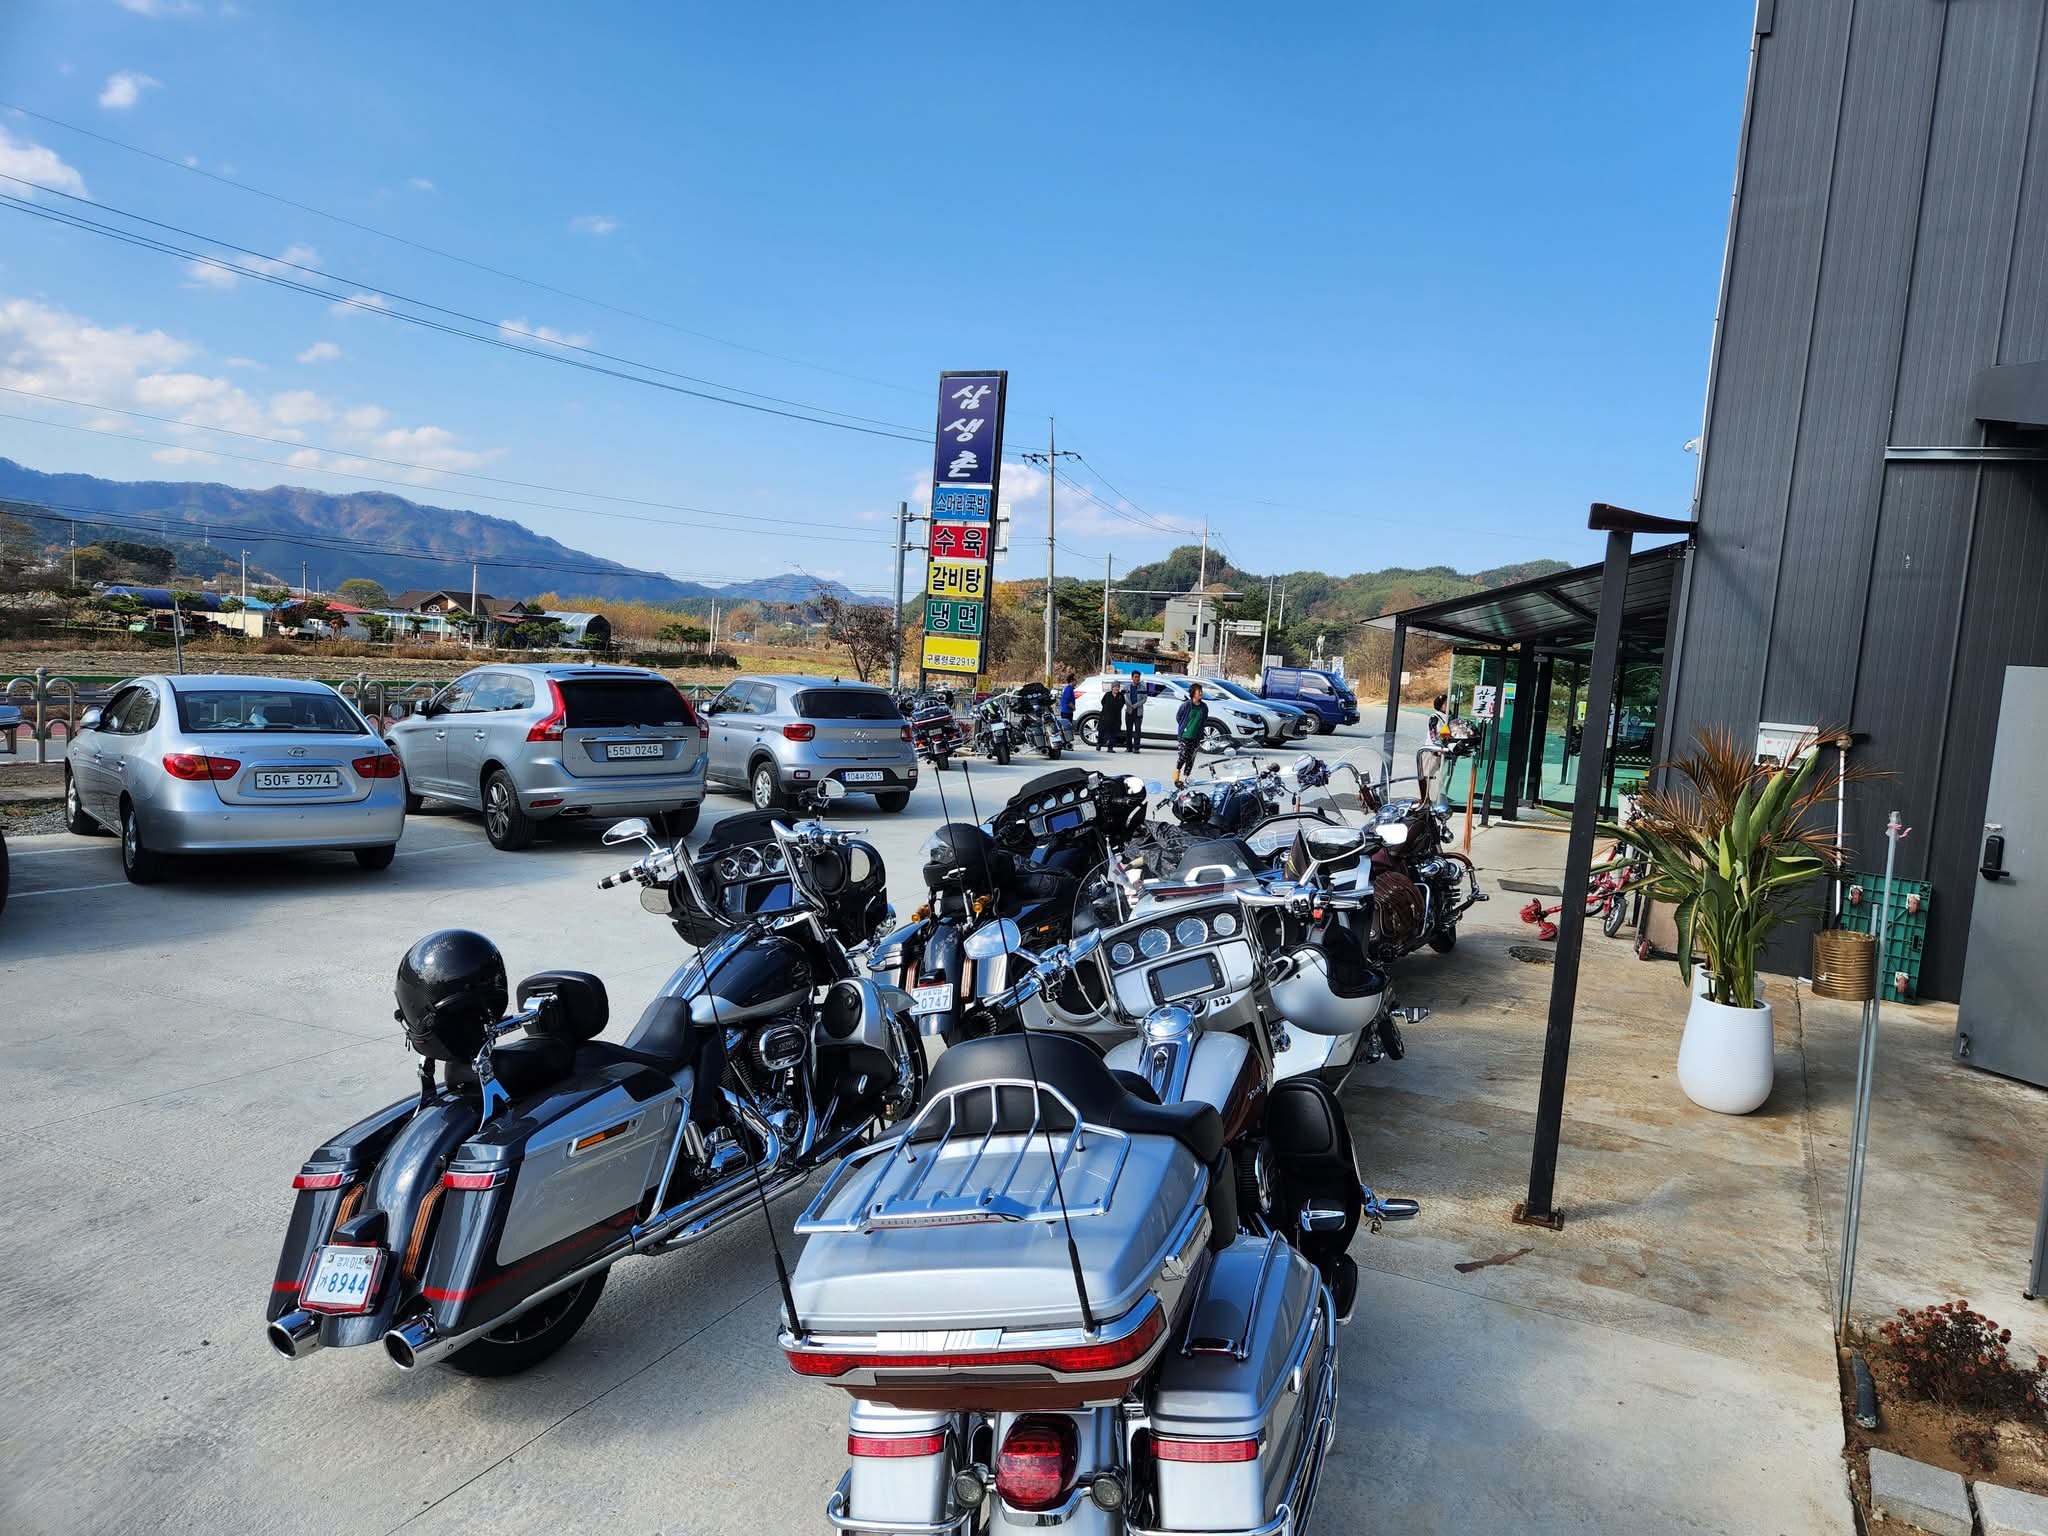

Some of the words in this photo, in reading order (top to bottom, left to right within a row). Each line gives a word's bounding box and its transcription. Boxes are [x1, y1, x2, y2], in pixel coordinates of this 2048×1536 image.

[944, 384, 991, 478] 삼생촌
[935, 490, 988, 516] 소머리국밥
[933, 566, 981, 593] 갈비탕
[634, 745, 658, 755] 0248
[297, 772, 331, 786] 5974
[327, 1272, 369, 1295] 8944
